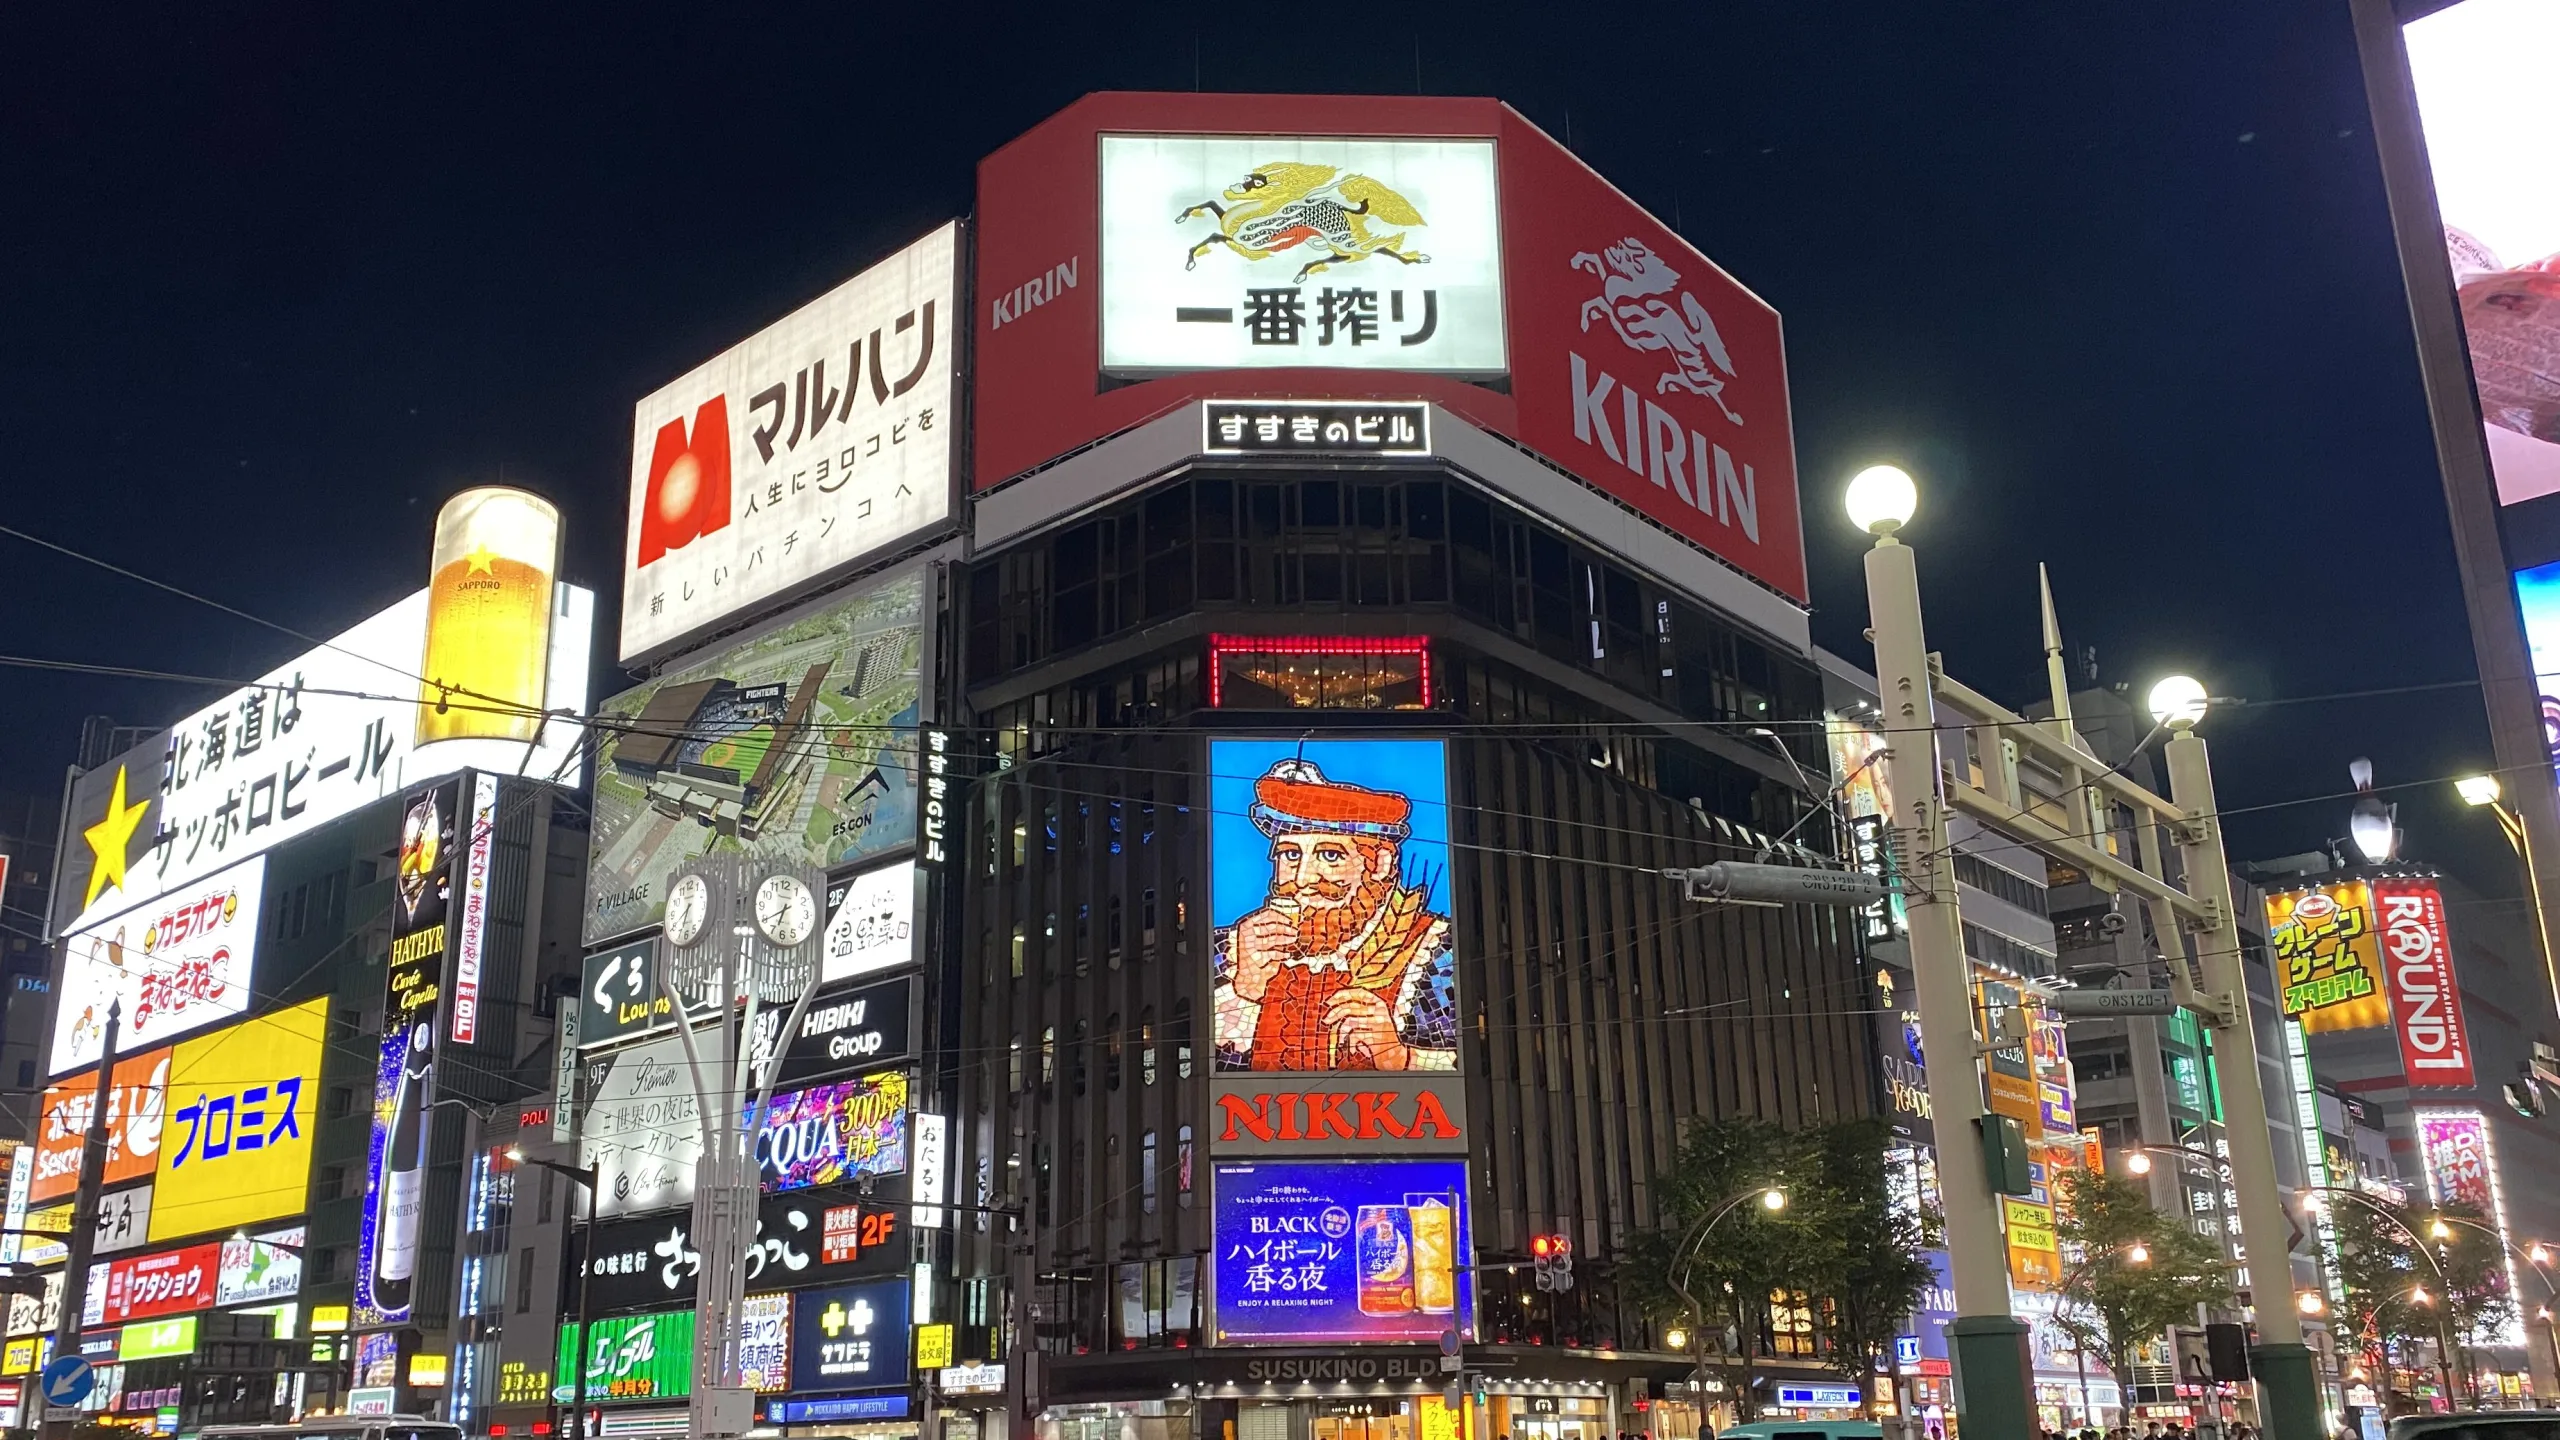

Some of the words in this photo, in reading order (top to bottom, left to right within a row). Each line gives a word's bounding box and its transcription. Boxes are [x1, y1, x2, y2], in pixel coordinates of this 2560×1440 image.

[992, 256, 1078, 331] KIRIN
[1176, 286, 1438, 346] 一番搾り
[749, 299, 934, 465] マルハン
[1217, 413, 1416, 442] すすきのビル
[744, 408, 933, 518] 人生にヨロコビを
[1570, 350, 1759, 545] KIRIN
[650, 484, 912, 616] 新しいパチンコへ
[457, 580, 501, 592] SAPPORO
[746, 687, 778, 699] FIGHTERS
[161, 671, 304, 797] 北海道は
[154, 716, 394, 880] サッポロビール
[833, 822, 846, 837] ES
[848, 813, 872, 832] CON
[607, 883, 649, 910] VILLAGE
[679, 887, 685, 897] 11
[685, 880, 694, 891] 12
[763, 891, 772, 900] 10
[770, 882, 778, 892] 11
[781, 880, 791, 890] 12
[828, 888, 845, 908] 2F
[673, 898, 681, 907] 10
[155, 892, 228, 952] カラオケ
[2274, 907, 2364, 957] クレーン
[391, 925, 444, 967] HATHYR
[2292, 943, 2357, 983] ゲーム
[2424, 896, 2441, 944] SPORTS
[2434, 947, 2461, 1049] ENTERTAINMENT
[392, 968, 421, 992] Cuvée
[2286, 969, 2373, 1013] スタジアム
[2383, 895, 2465, 1069] ROUND1
[401, 984, 438, 1011] Capella
[619, 993, 680, 1025] Loung
[457, 1000, 474, 1037] 8F
[802, 1000, 866, 1037] HIBIKI
[829, 1031, 882, 1060] Group
[556, 1047, 573, 1126] グリーンビル
[590, 1062, 607, 1087] 9F
[840, 1085, 901, 1133] 300坪
[1216, 1090, 1461, 1142] NIKKA
[1892, 1080, 1933, 1120] YGGDR
[173, 1076, 302, 1169] プロミス
[846, 1134, 897, 1165] 日本一
[2454, 1132, 2482, 1182] DAM
[861, 1213, 894, 1246] 2F
[1250, 1217, 1318, 1233] BLACK
[1227, 1239, 1342, 1262] ハイボール
[133, 1264, 202, 1304] ワタショウ
[218, 1281, 230, 1302] 1F
[1243, 1261, 1328, 1292] 香る夜
[586, 1320, 656, 1378] エイブル
[1248, 1358, 1377, 1379] SUSUKINO
[1387, 1358, 1443, 1377] BLD.
[815, 1405, 840, 1415] HOKKAIDO
[843, 1403, 859, 1413] HAPPY
[860, 1401, 888, 1412] LIFESTYLE
[1816, 1391, 1845, 1402] LAWSON
